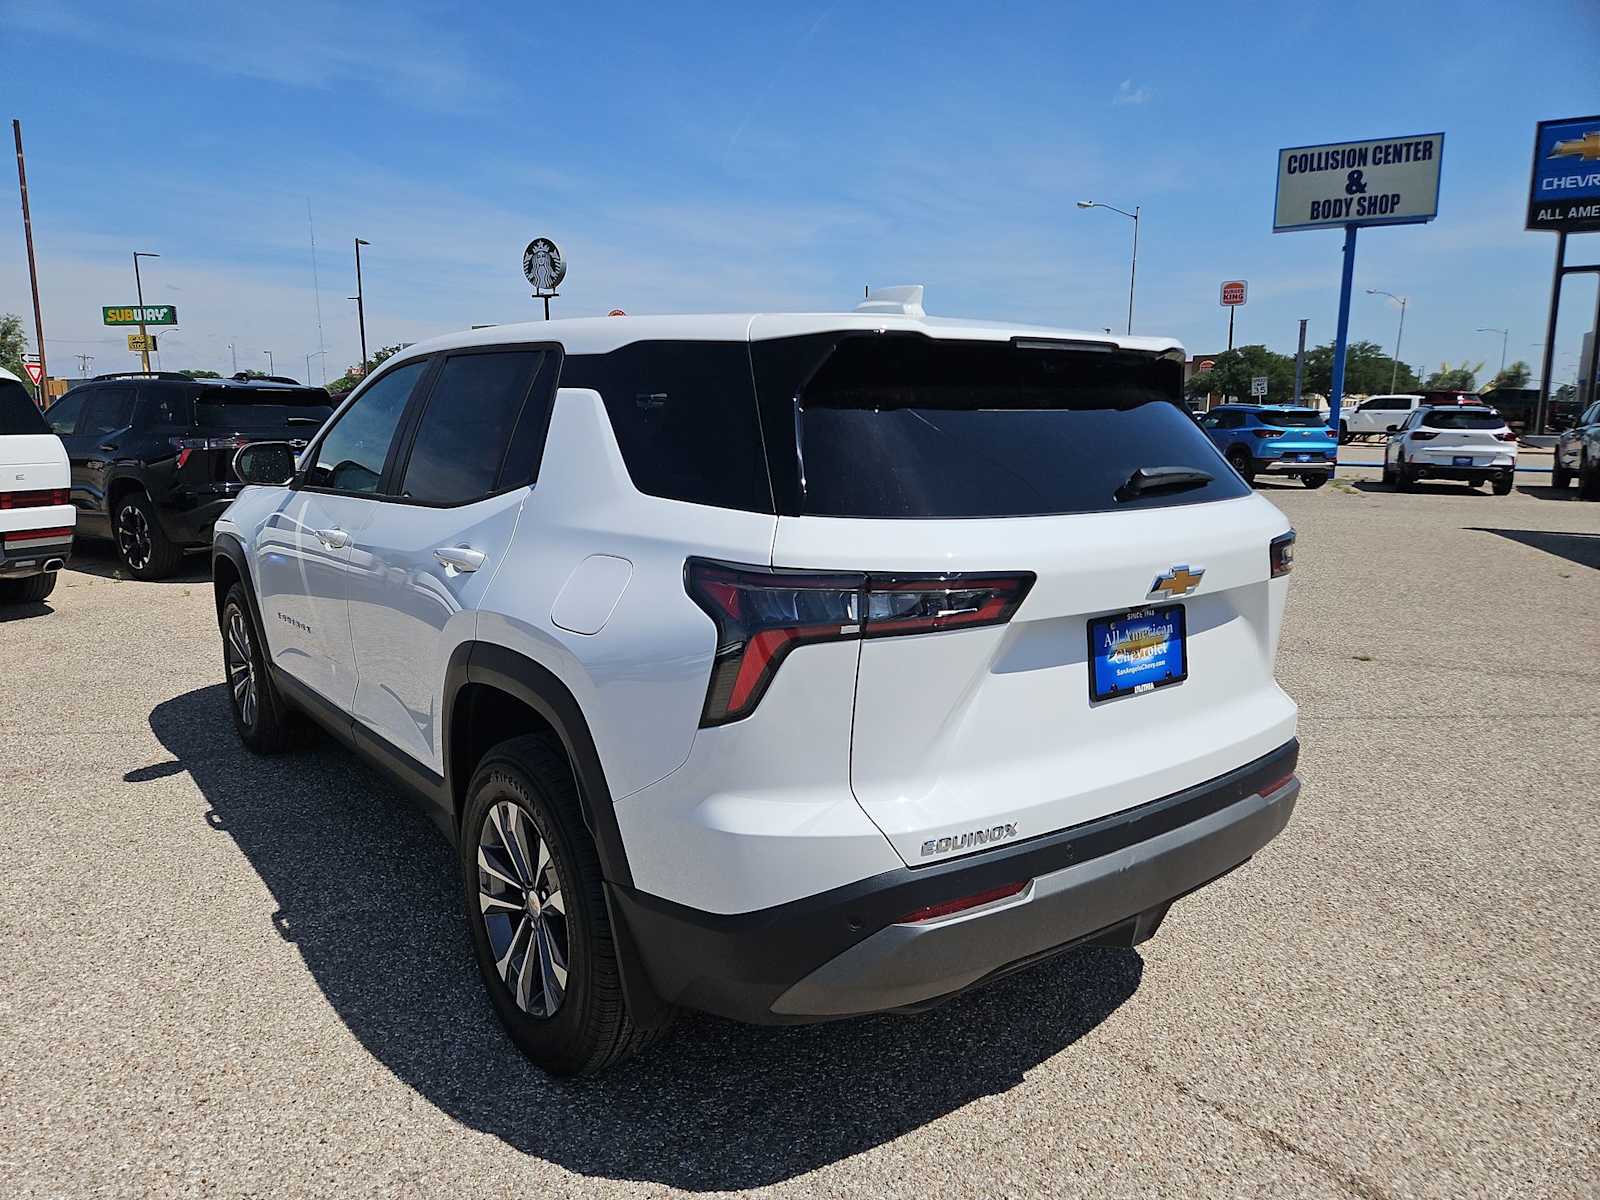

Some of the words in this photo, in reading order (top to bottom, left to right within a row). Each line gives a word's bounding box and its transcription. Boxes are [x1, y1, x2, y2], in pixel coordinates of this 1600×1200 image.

[1287, 147, 1369, 175] COLLISION
[1371, 140, 1433, 166] CENTER
[1345, 169, 1367, 195] &
[1310, 197, 1354, 220] BODY
[1356, 193, 1400, 217] SHOP
[1537, 208, 1564, 221] ALL
[1223, 293, 1245, 301] KING
[106, 308, 168, 321] SUBWAY
[1103, 629, 1120, 648] All
[1124, 623, 1174, 642] American
[1114, 640, 1168, 664] Chevrolet
[920, 821, 1018, 857] EQUINOX
